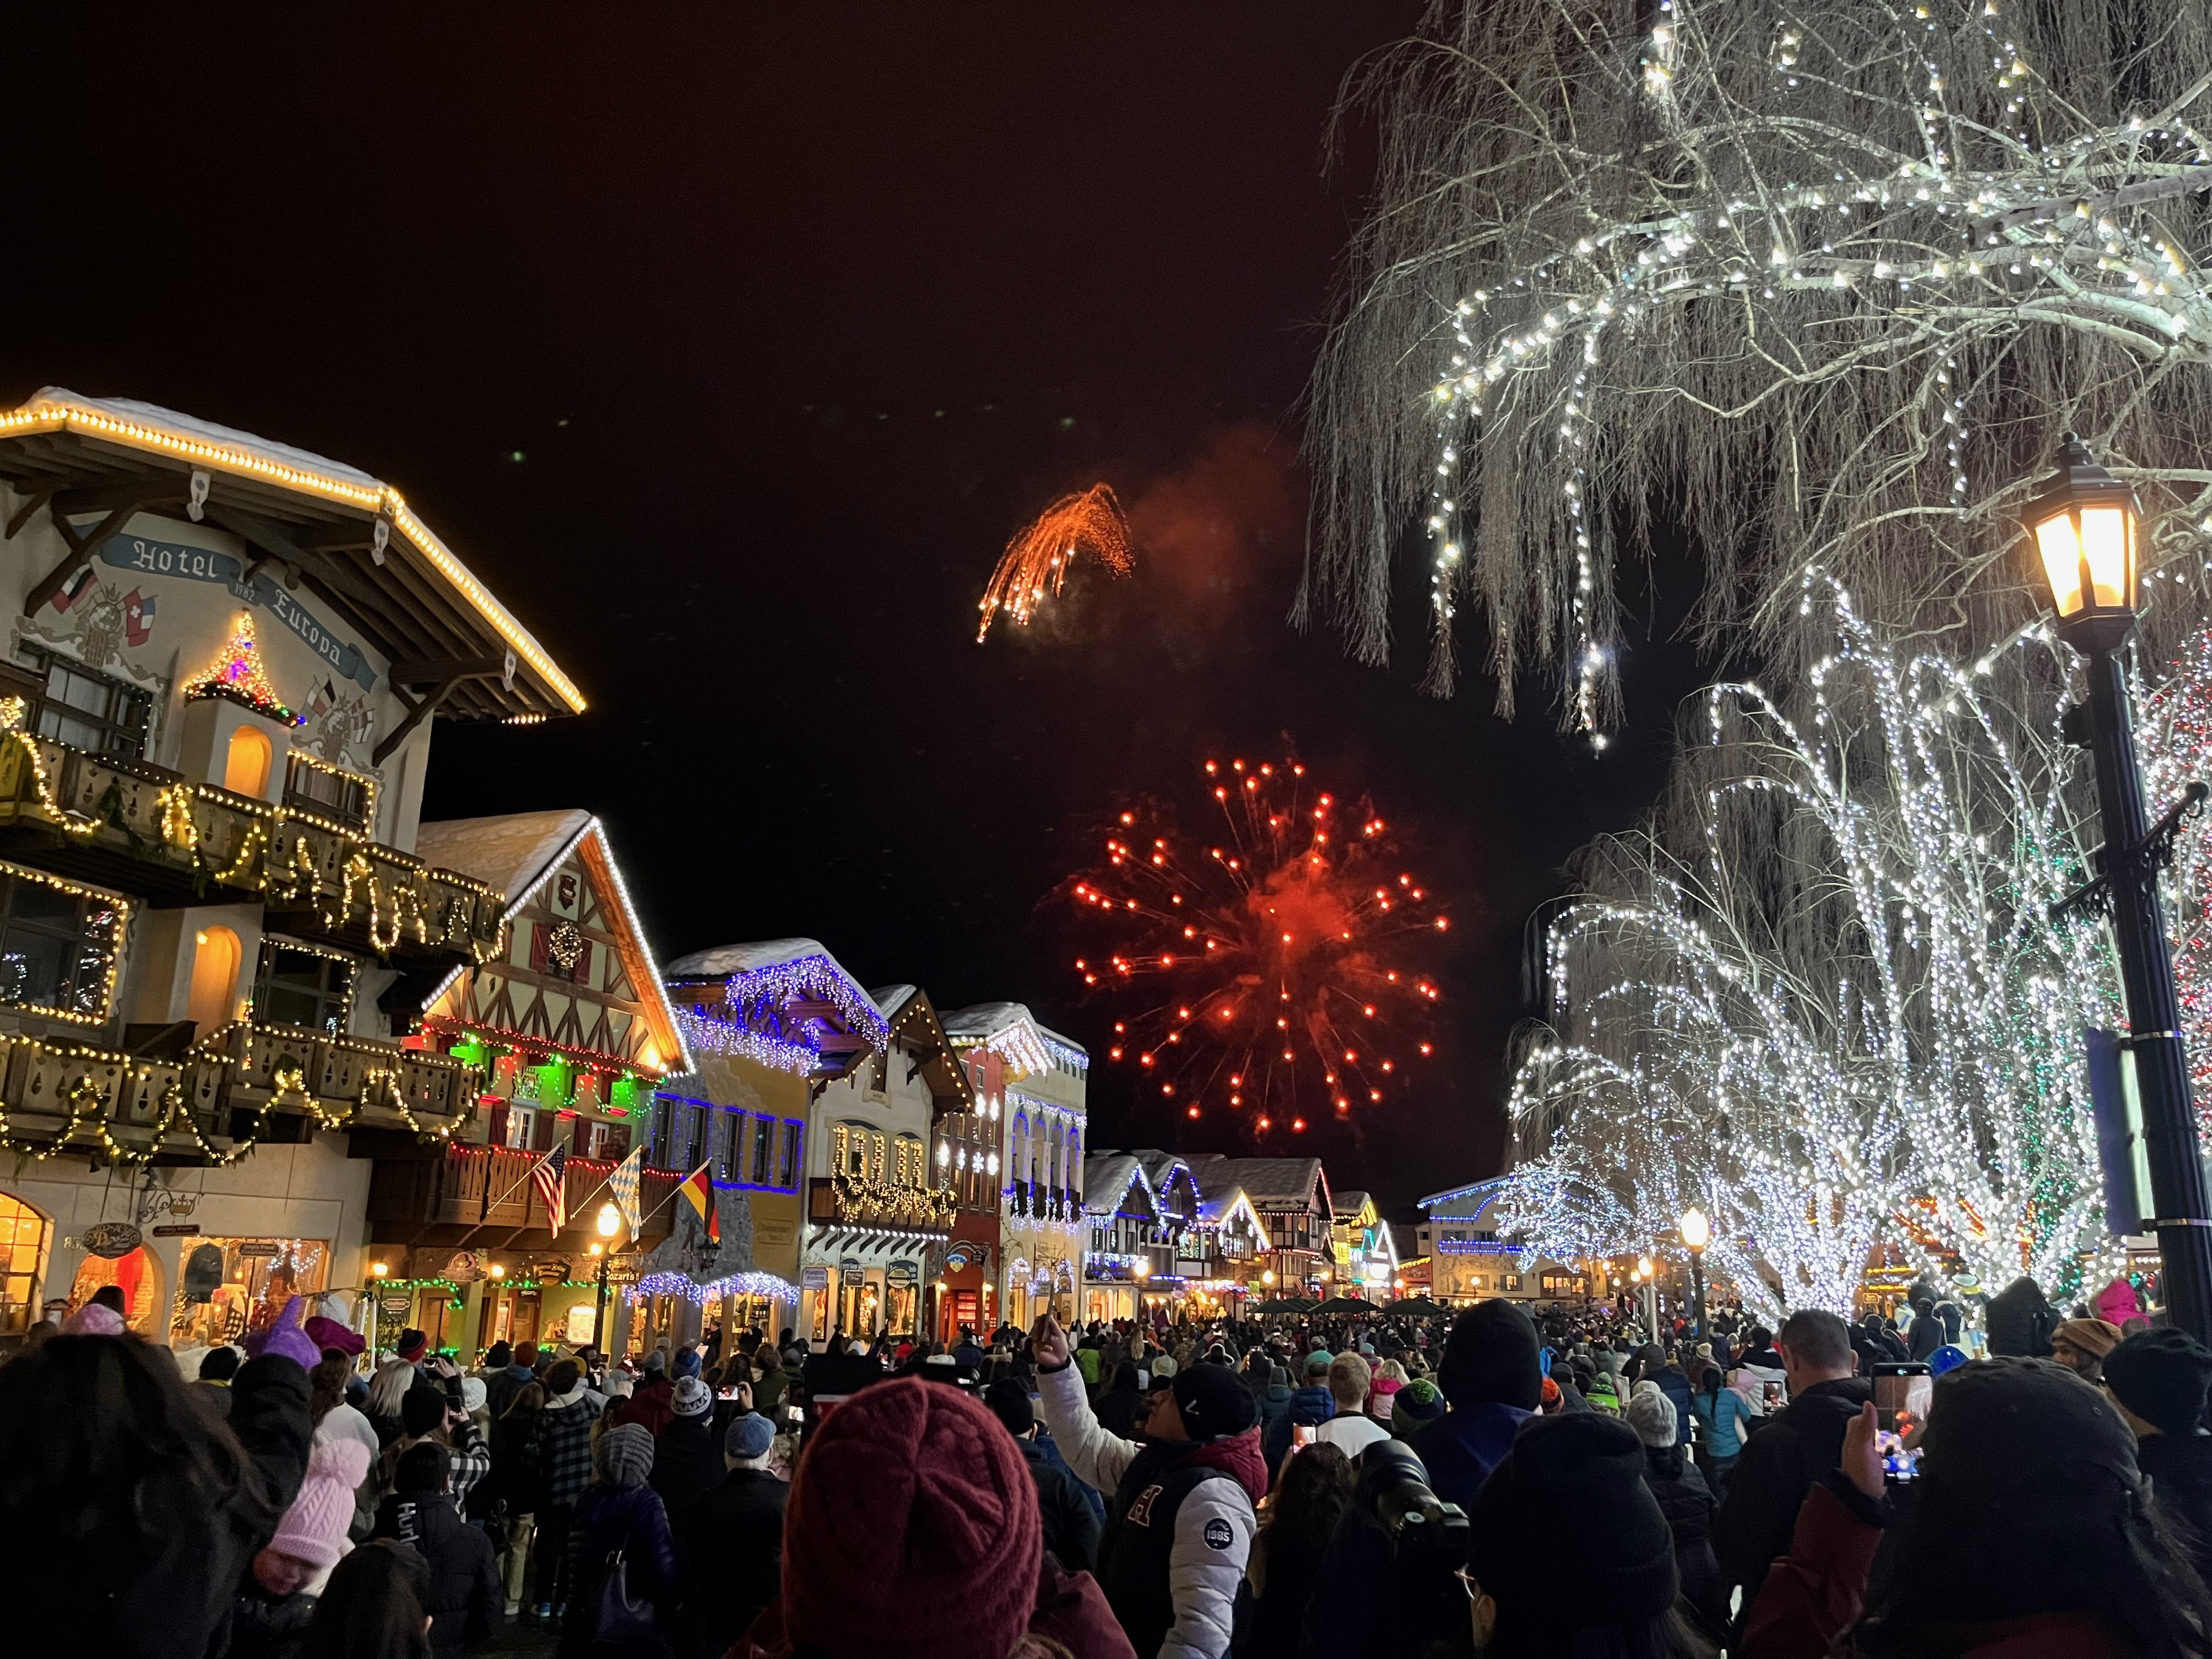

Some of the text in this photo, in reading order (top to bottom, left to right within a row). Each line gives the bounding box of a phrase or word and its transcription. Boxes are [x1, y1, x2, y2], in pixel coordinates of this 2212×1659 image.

[132, 541, 342, 666] Hotel Europa
[235, 583, 255, 602] 1982
[398, 1502, 420, 1544] Hurl
[1207, 1529, 1230, 1542] 1985
